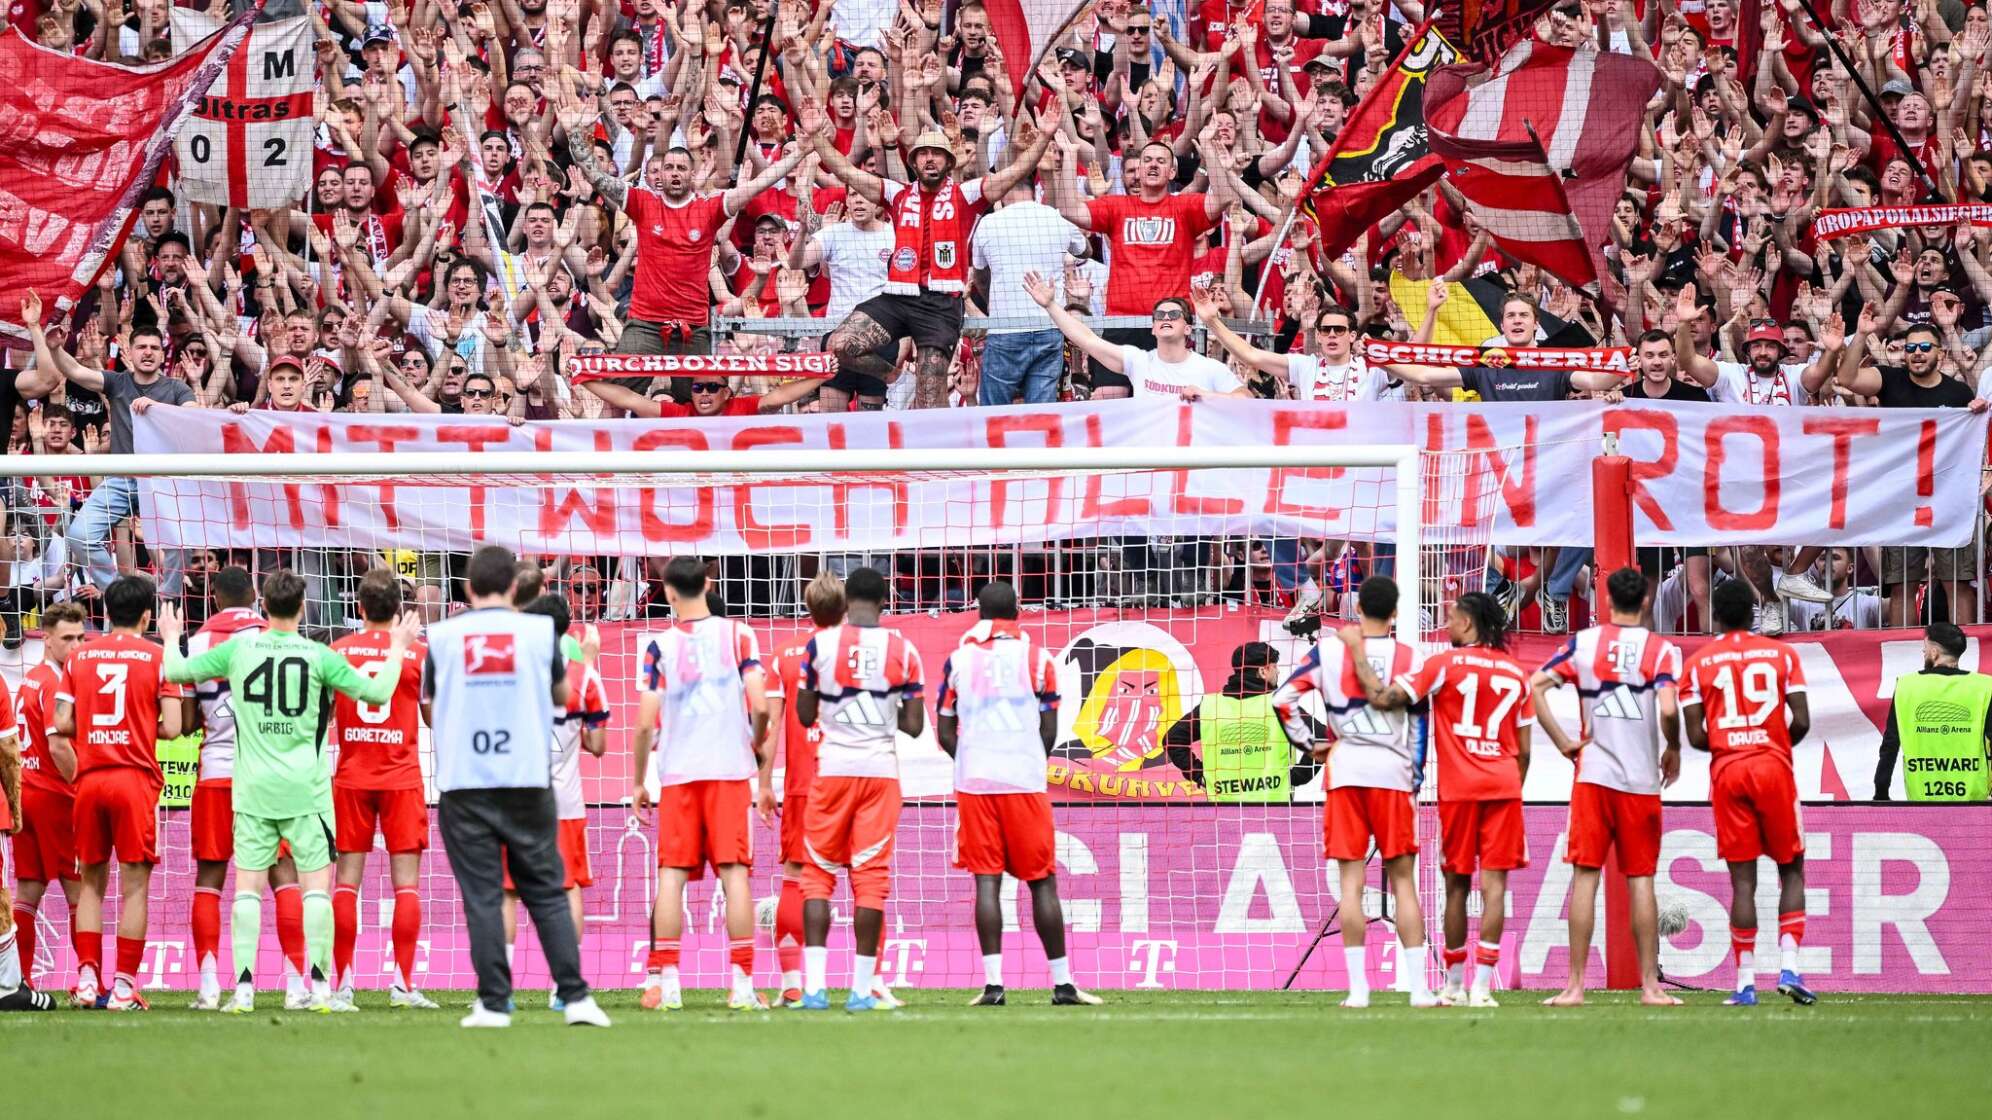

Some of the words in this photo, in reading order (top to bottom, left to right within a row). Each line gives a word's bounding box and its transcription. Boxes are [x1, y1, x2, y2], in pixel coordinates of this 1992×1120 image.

[263, 50, 295, 80] M
[263, 137, 288, 167] 2
[570, 354, 768, 377] DURCHBOXEN
[221, 421, 910, 549] MITTWOCH
[986, 405, 1347, 529] ALLE
[1420, 413, 1538, 528] IN
[1602, 409, 1937, 530] ROT!
[92, 663, 129, 726] 3
[243, 656, 309, 718] 40
[1711, 661, 1780, 729] 19
[1452, 672, 1522, 740] 17
[88, 730, 130, 745] MINJAE
[258, 721, 294, 736] URBIG
[344, 726, 404, 745] GORETZKA
[1727, 729, 1770, 746] DAVIES
[1916, 725, 1939, 734] Allianz
[1951, 725, 1972, 733] Arena
[472, 729, 512, 755] 02
[158, 760, 199, 775] TEWA
[1907, 757, 1980, 773] STEWARD
[1213, 775, 1282, 795] STEWARD
[1924, 781, 1967, 797] 1266
